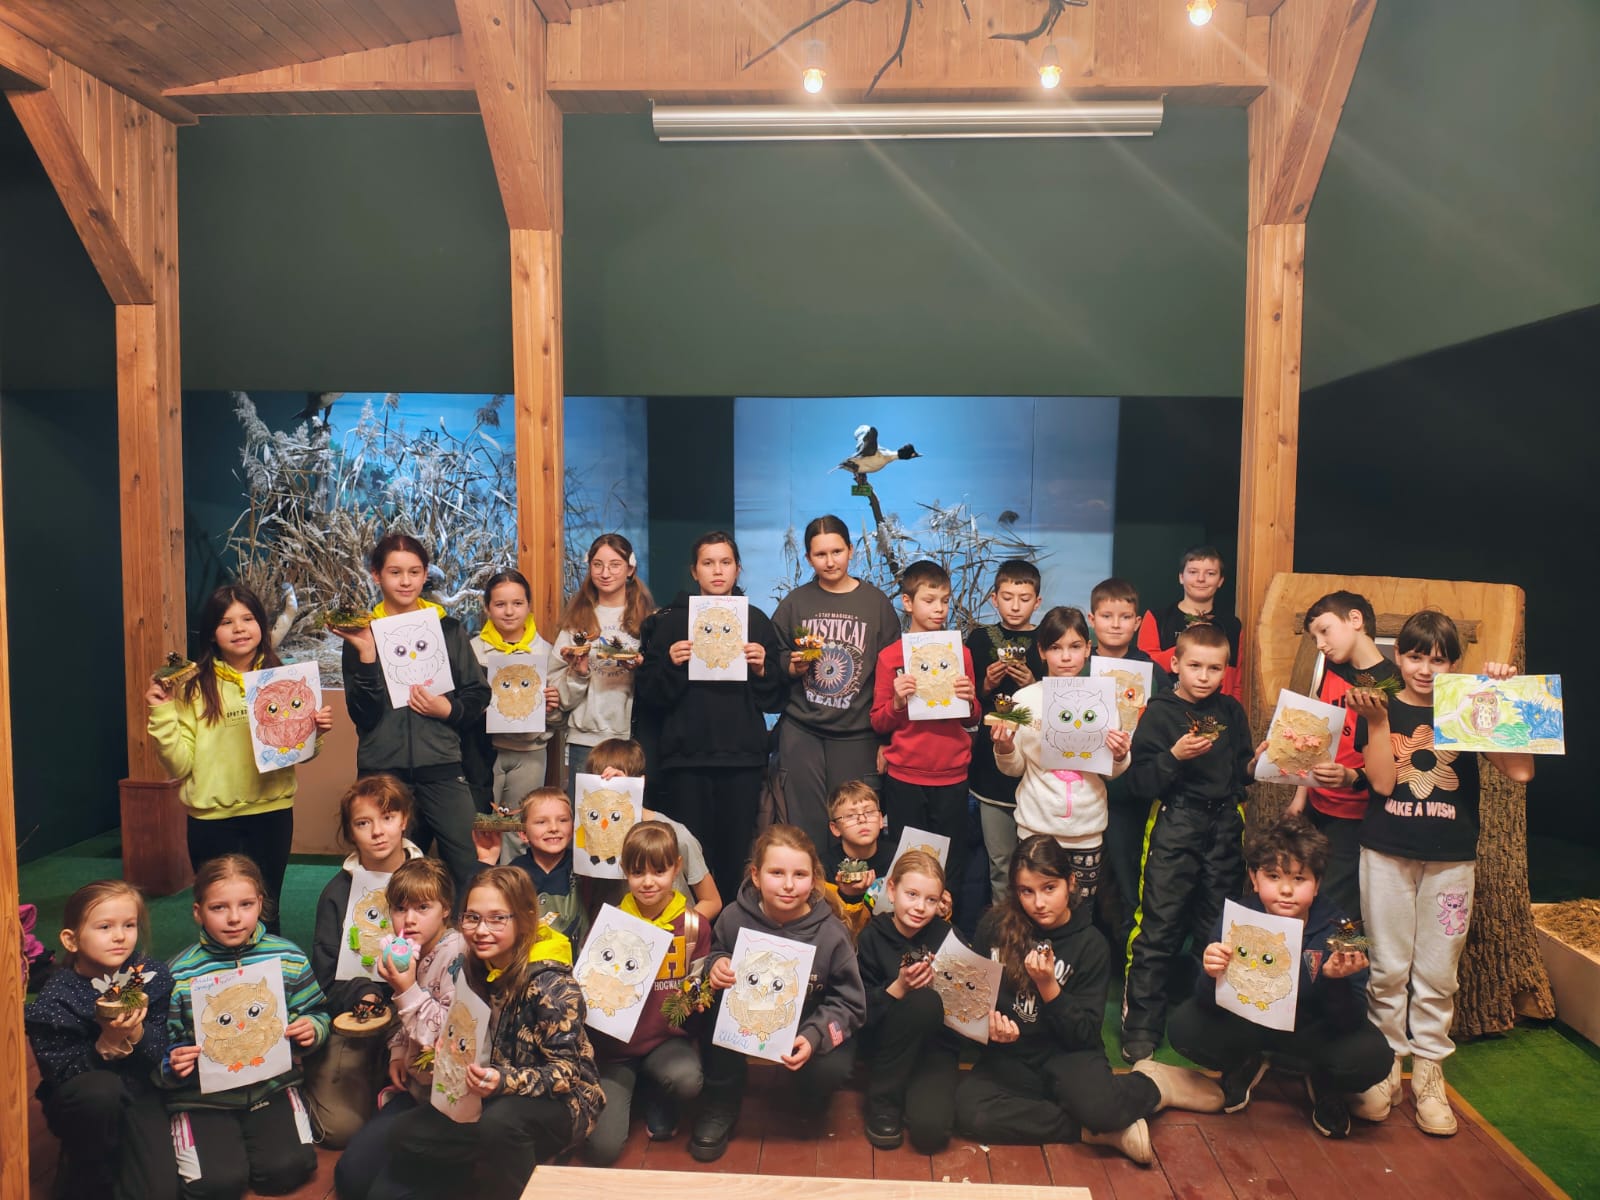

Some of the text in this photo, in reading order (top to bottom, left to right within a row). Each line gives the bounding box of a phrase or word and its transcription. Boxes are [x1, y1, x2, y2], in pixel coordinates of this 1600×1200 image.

[805, 690, 855, 710] REAMS
[1414, 802, 1424, 817] A
[1426, 801, 1456, 820] WISH
[654, 981, 682, 991] HOGWA
